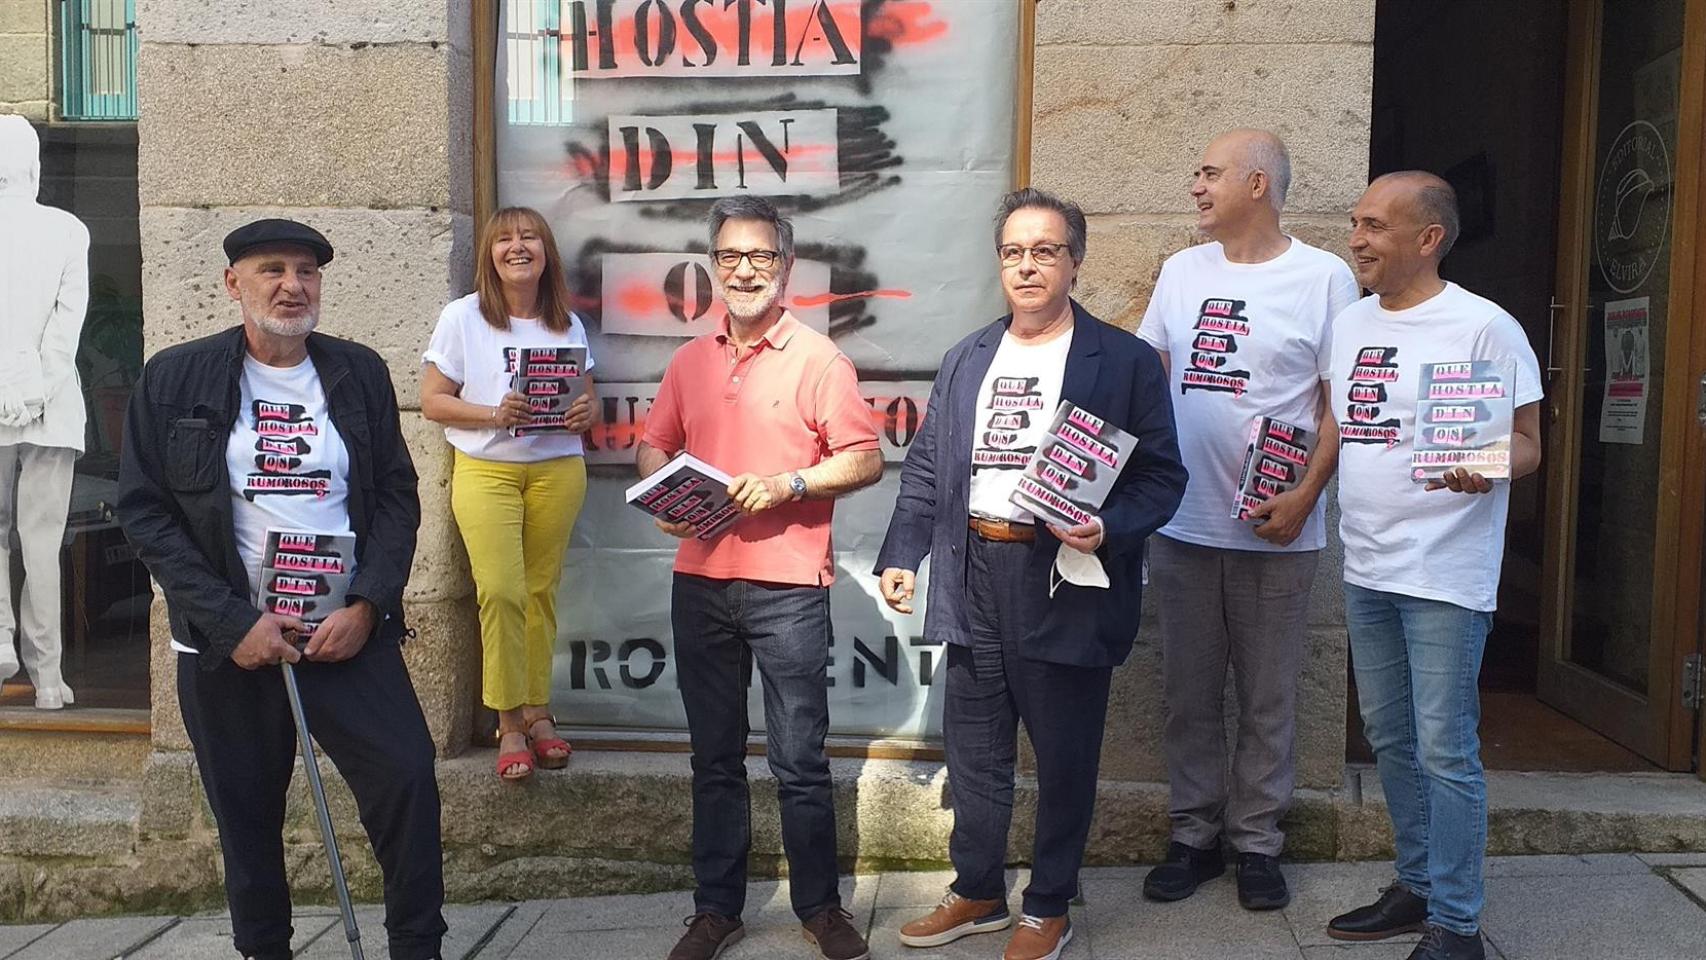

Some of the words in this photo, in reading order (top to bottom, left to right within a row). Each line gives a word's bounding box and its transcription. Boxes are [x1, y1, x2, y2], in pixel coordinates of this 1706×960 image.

[572, 0, 857, 70] HOSTIA
[619, 118, 795, 191] DIN
[1609, 256, 1648, 281] ELVIRA
[1208, 302, 1230, 312] QUE
[1202, 318, 1246, 332] HOSTIA
[1200, 337, 1225, 348] DIN
[1199, 354, 1215, 366] OS
[1362, 350, 1383, 360] QUE
[529, 365, 576, 373] HOSTIA
[1355, 367, 1395, 378] HOSTIA
[1436, 364, 1470, 375] QUE
[1183, 372, 1244, 387] RUMOROSOS
[532, 383, 558, 392] DIN
[1000, 381, 1024, 391] QUE
[1432, 383, 1499, 395] HOSTIA
[1354, 388, 1377, 399] DIN
[995, 398, 1040, 407] HOSTIA
[260, 404, 288, 415] QUE
[1356, 407, 1370, 420] OS
[1435, 408, 1472, 418] DIN
[995, 416, 1019, 426] DIN
[1073, 409, 1102, 432] QUE
[260, 422, 314, 434] HOSTIA
[1271, 422, 1293, 434] QUE
[1437, 428, 1459, 440] OS
[991, 434, 1008, 445] OS
[1060, 425, 1115, 462] HOSTIA
[265, 440, 295, 452] DIN
[1265, 438, 1306, 461] HOSTIA
[267, 456, 287, 469] OS
[1053, 448, 1086, 472] DIN
[1413, 451, 1506, 463] RUMOROSOS
[1263, 460, 1286, 474] DIN
[1046, 467, 1066, 486] OS
[247, 477, 326, 489] RUMOROSOS
[1018, 477, 1092, 524] RUMOROSOS
[282, 534, 314, 546] QUE
[277, 555, 339, 570] HOSTIA
[279, 578, 315, 591] DIN
[278, 599, 301, 613] OS
